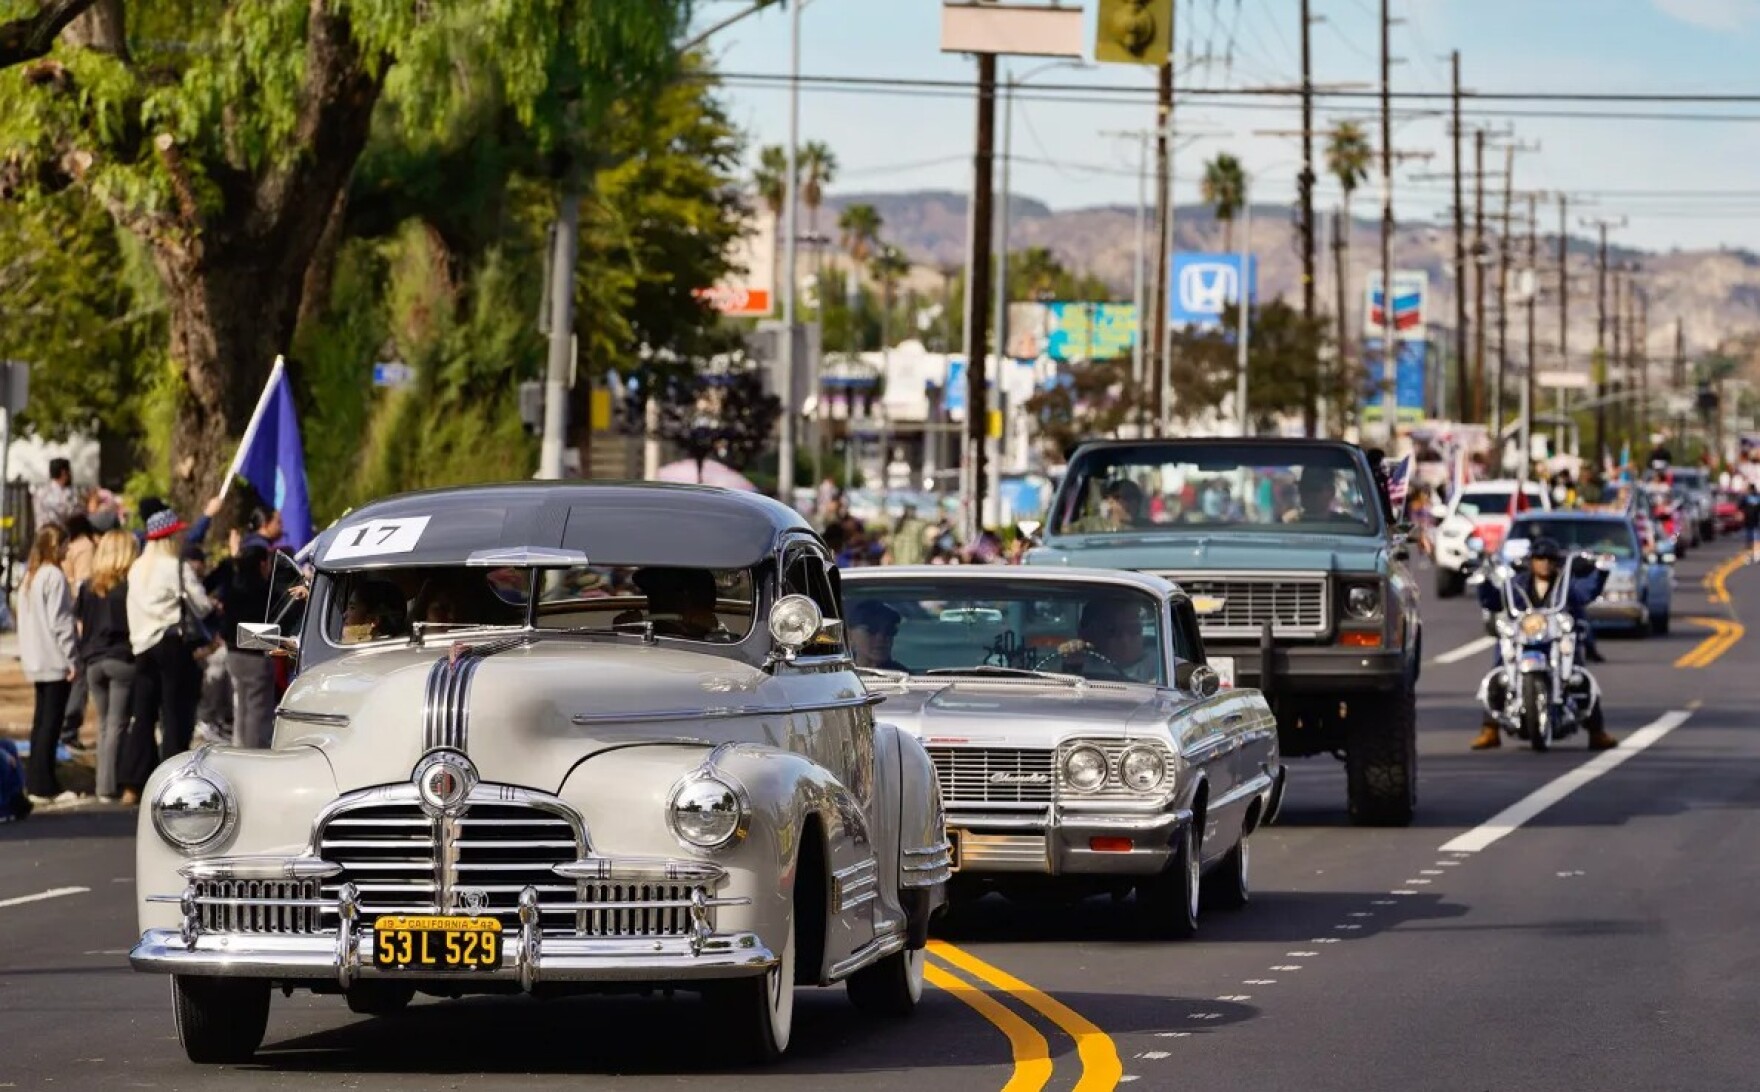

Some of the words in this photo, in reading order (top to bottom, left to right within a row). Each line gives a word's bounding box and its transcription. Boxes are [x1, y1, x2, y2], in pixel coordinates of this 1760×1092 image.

[350, 525, 402, 547] 17
[382, 919, 395, 929] 19
[408, 919, 469, 929] CALIFORNIA
[380, 931, 412, 963] 53
[421, 931, 436, 963] L
[446, 931, 496, 964] 529
